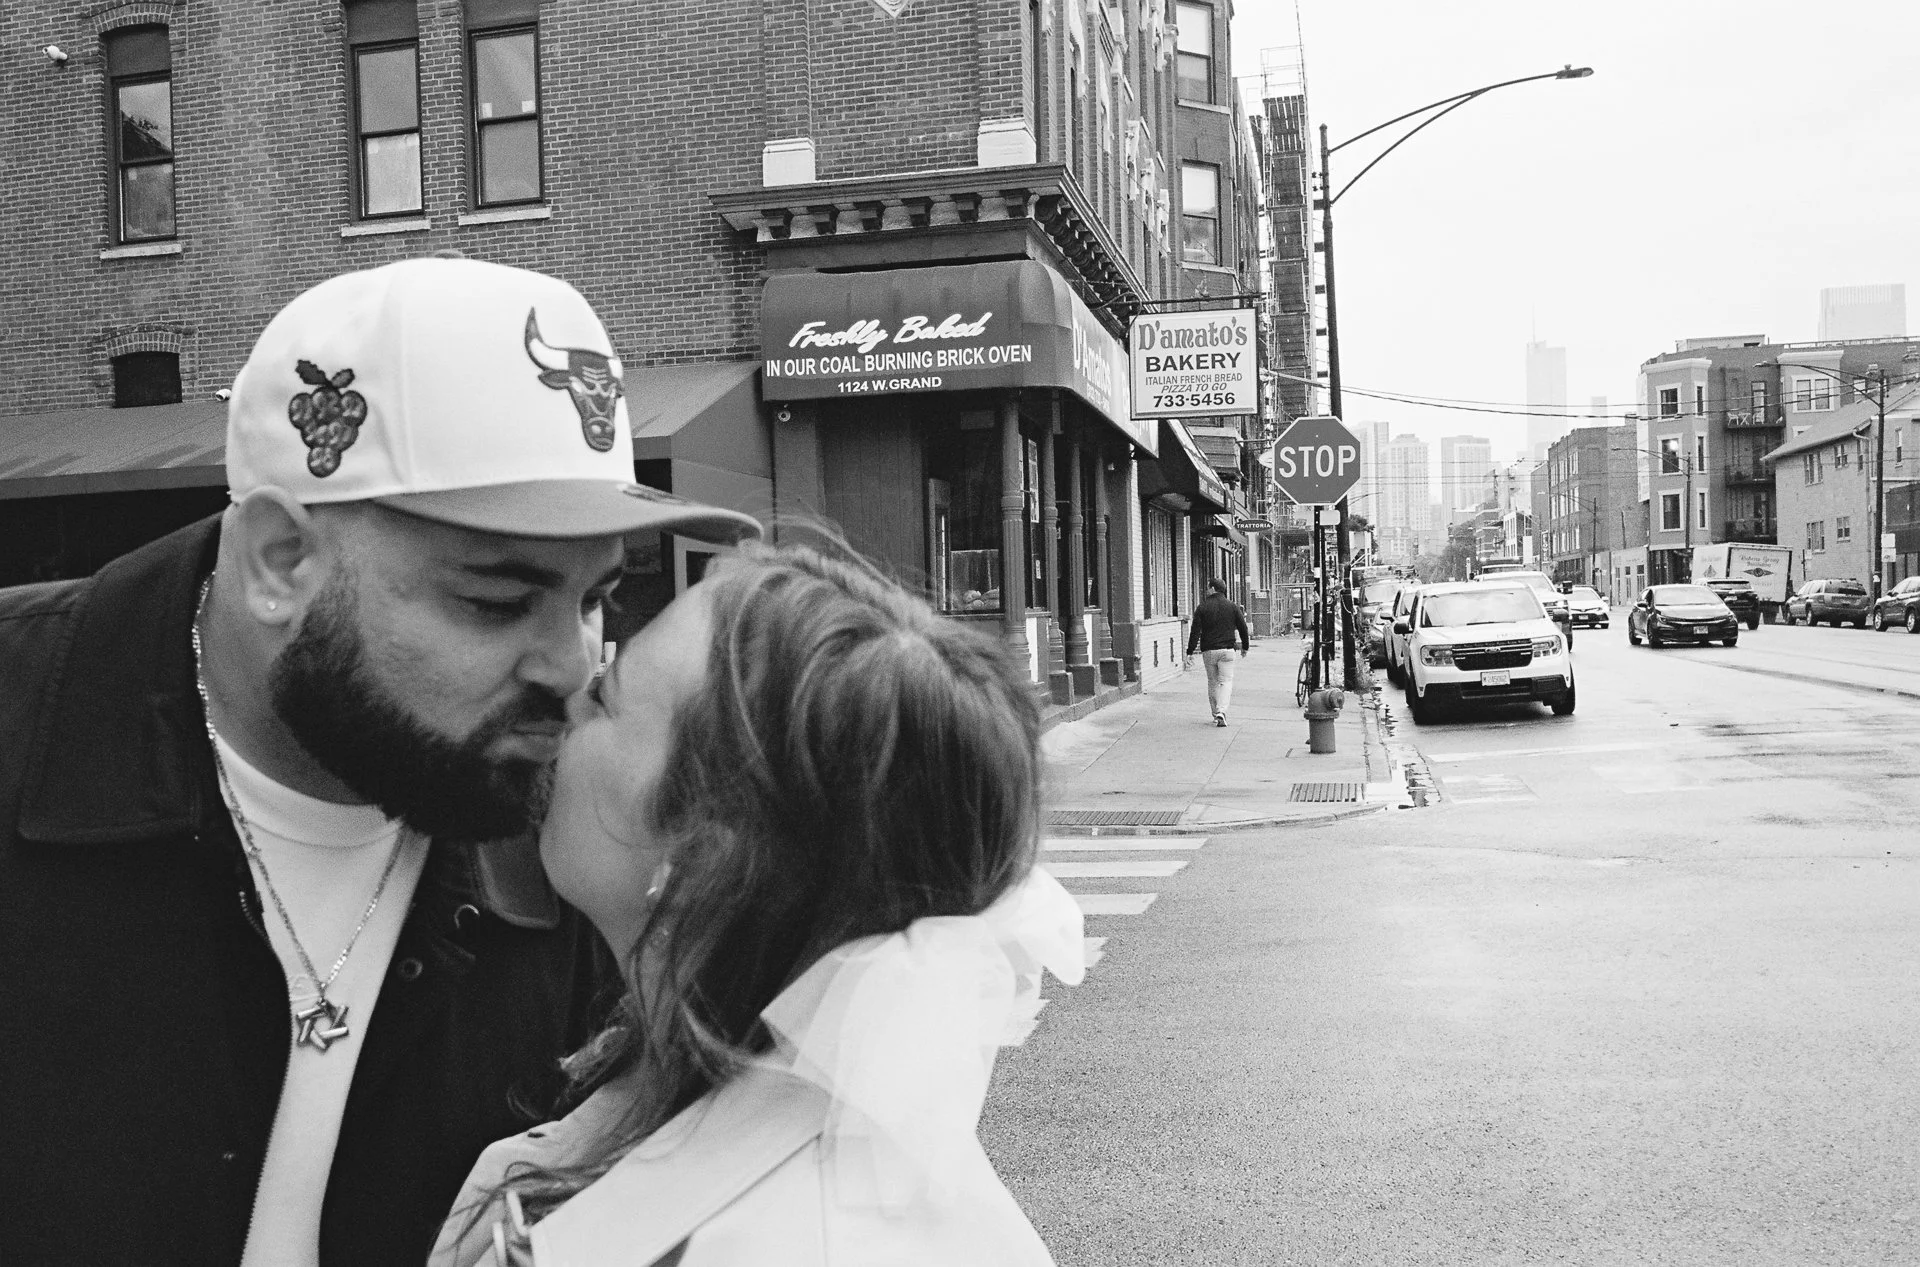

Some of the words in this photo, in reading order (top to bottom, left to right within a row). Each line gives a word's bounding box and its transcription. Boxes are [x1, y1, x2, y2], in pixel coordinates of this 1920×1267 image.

[788, 319, 888, 354] Freshly
[893, 312, 993, 343] Baked
[1138, 316, 1248, 351] D'amato's
[766, 360, 780, 377] IN
[784, 358, 817, 376] OUR
[820, 355, 860, 374] COAL
[864, 350, 933, 372] BURNING
[937, 347, 985, 367] BRICK
[988, 344, 1032, 363] OVEN
[1146, 352, 1241, 373] BAKERY
[837, 381, 869, 393] 1124
[1145, 376, 1178, 386] ITALIAN
[1180, 374, 1212, 384] FRENCH
[1214, 373, 1243, 382] BREAD
[1161, 384, 1192, 394] PIZZA
[1195, 383, 1209, 392] TO
[1211, 382, 1227, 391] GO
[1278, 445, 1356, 478] STOP
